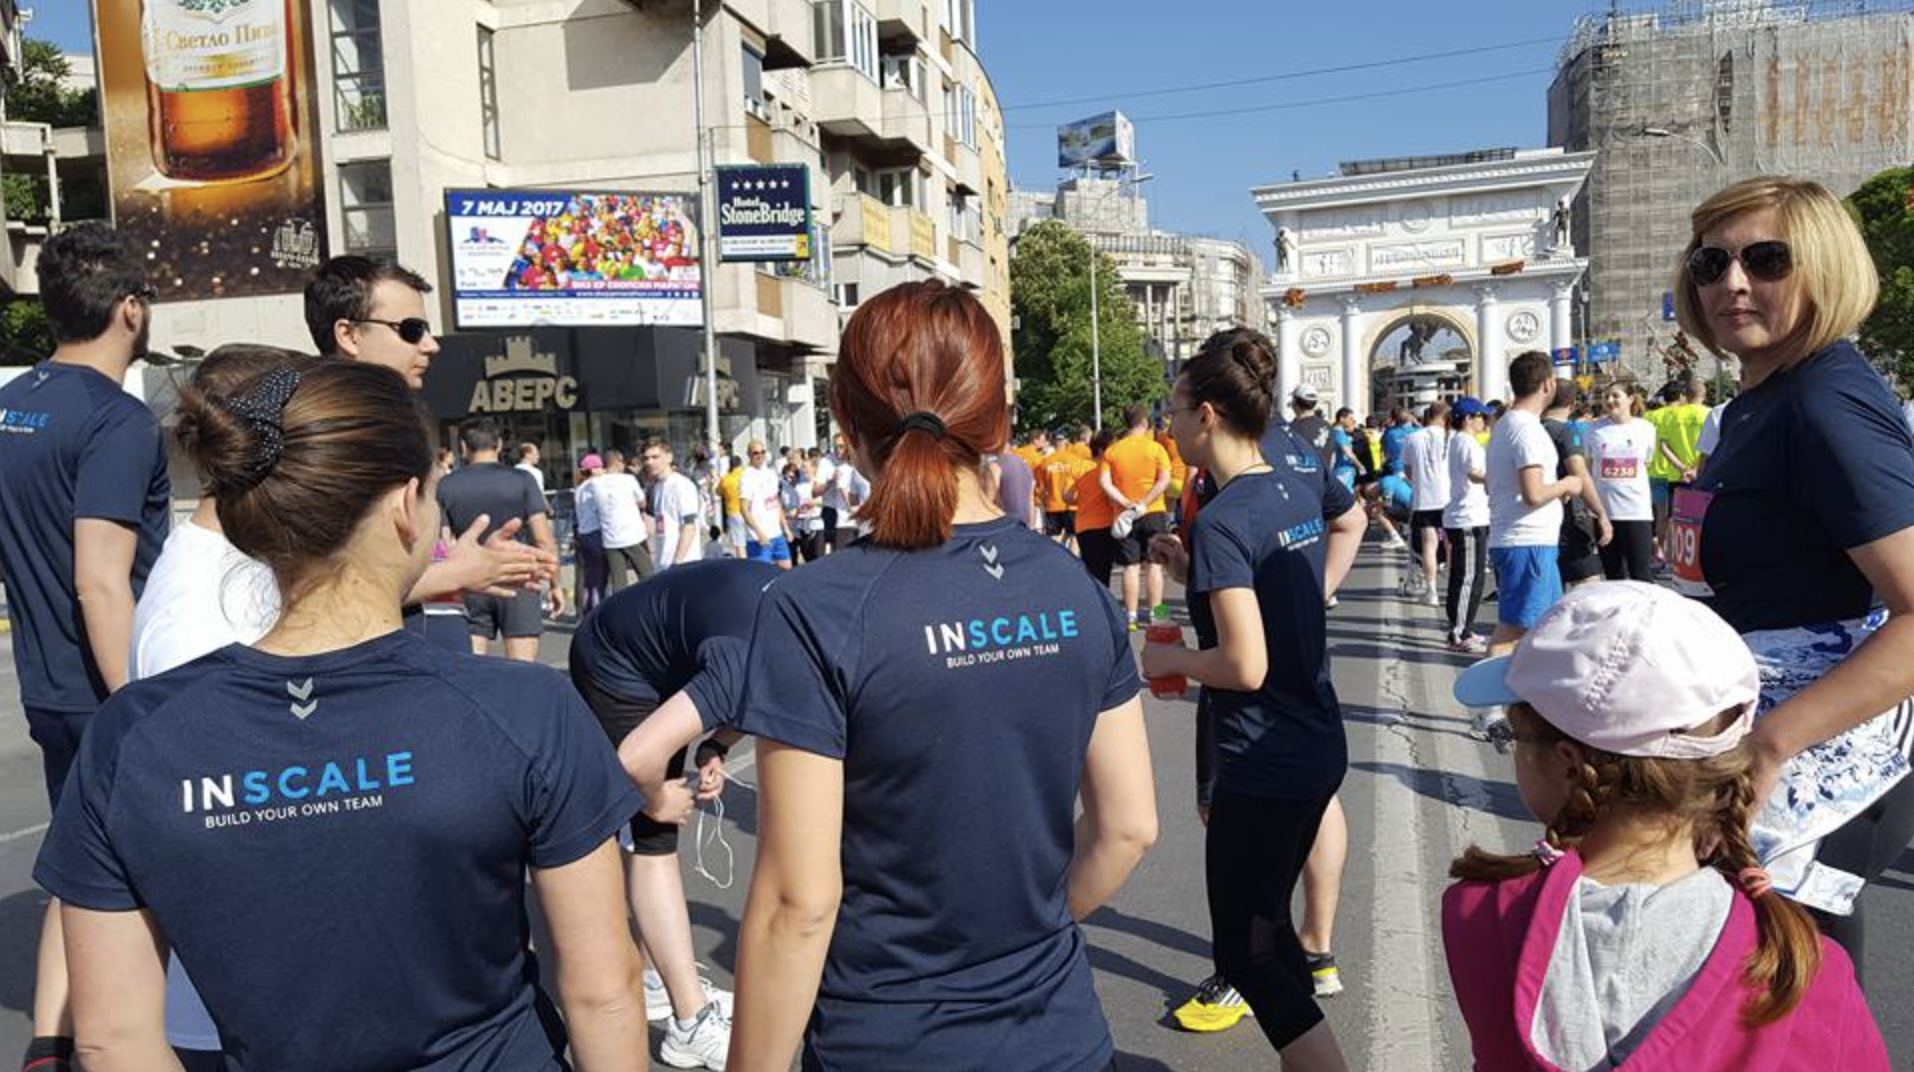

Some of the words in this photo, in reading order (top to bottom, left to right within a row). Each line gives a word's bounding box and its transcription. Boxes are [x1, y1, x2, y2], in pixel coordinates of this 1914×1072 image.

[461, 201, 475, 215] 7
[520, 201, 565, 216] 2017
[721, 201, 805, 227] StoneBridge
[733, 196, 760, 207] Hotel
[1671, 526, 1695, 567] 09
[925, 610, 1079, 655] INSCALE
[946, 654, 975, 669] BUILD
[978, 649, 1005, 664] YOUR
[1006, 647, 1031, 660] OWN
[1034, 643, 1059, 656] TEAM
[182, 751, 415, 813] INSCALE
[205, 810, 251, 829] BUILD
[255, 804, 298, 822] YOUR
[301, 800, 339, 816] OWN
[343, 795, 383, 811] TEAM
